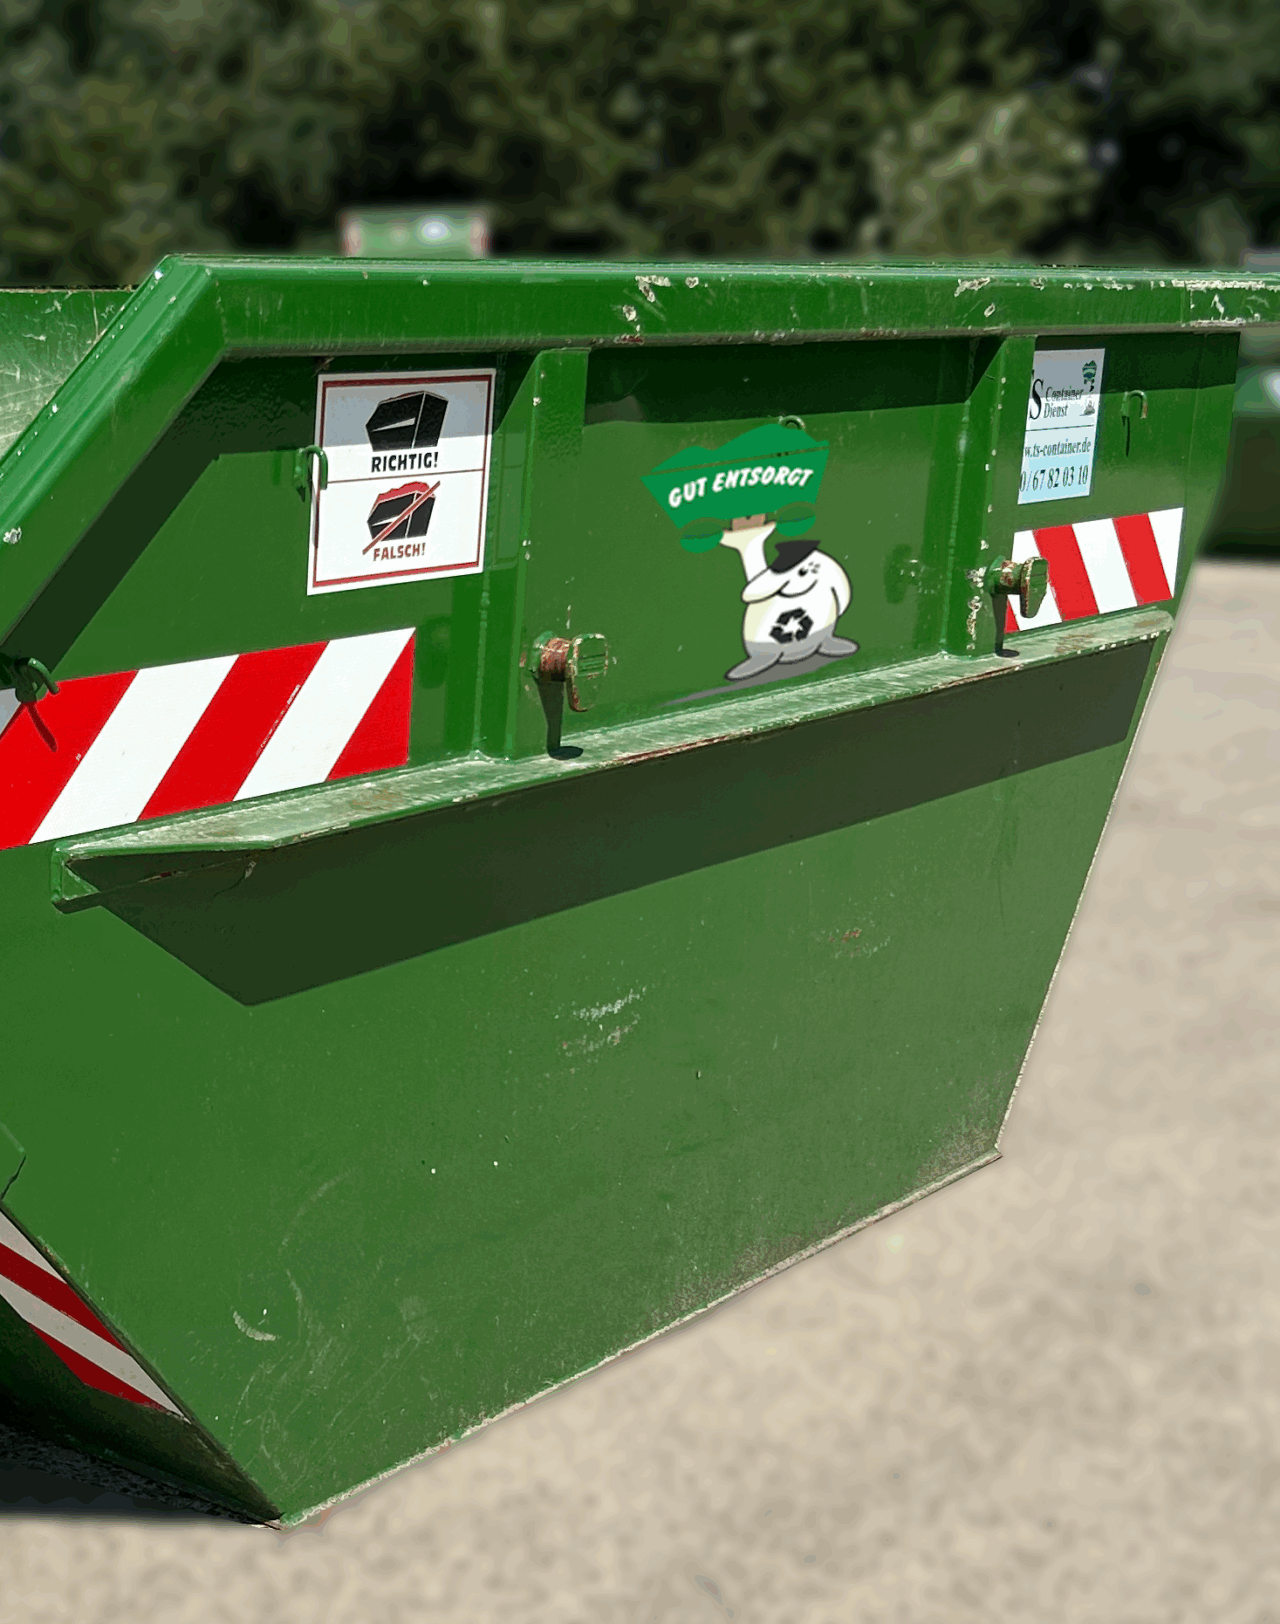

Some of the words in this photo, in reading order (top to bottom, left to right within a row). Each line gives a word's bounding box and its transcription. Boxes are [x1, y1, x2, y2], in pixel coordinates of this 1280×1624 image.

[1029, 369, 1044, 420] S
[1045, 386, 1084, 402] Container
[1043, 402, 1068, 418] Dienst
[371, 451, 439, 473] RICHTIG!
[668, 476, 708, 508] GUT
[712, 465, 814, 493] ENTSORGT
[1047, 467, 1060, 489] 82
[1062, 466, 1074, 487] 03
[1078, 464, 1089, 486] 10
[373, 542, 426, 562] FALSCH!
